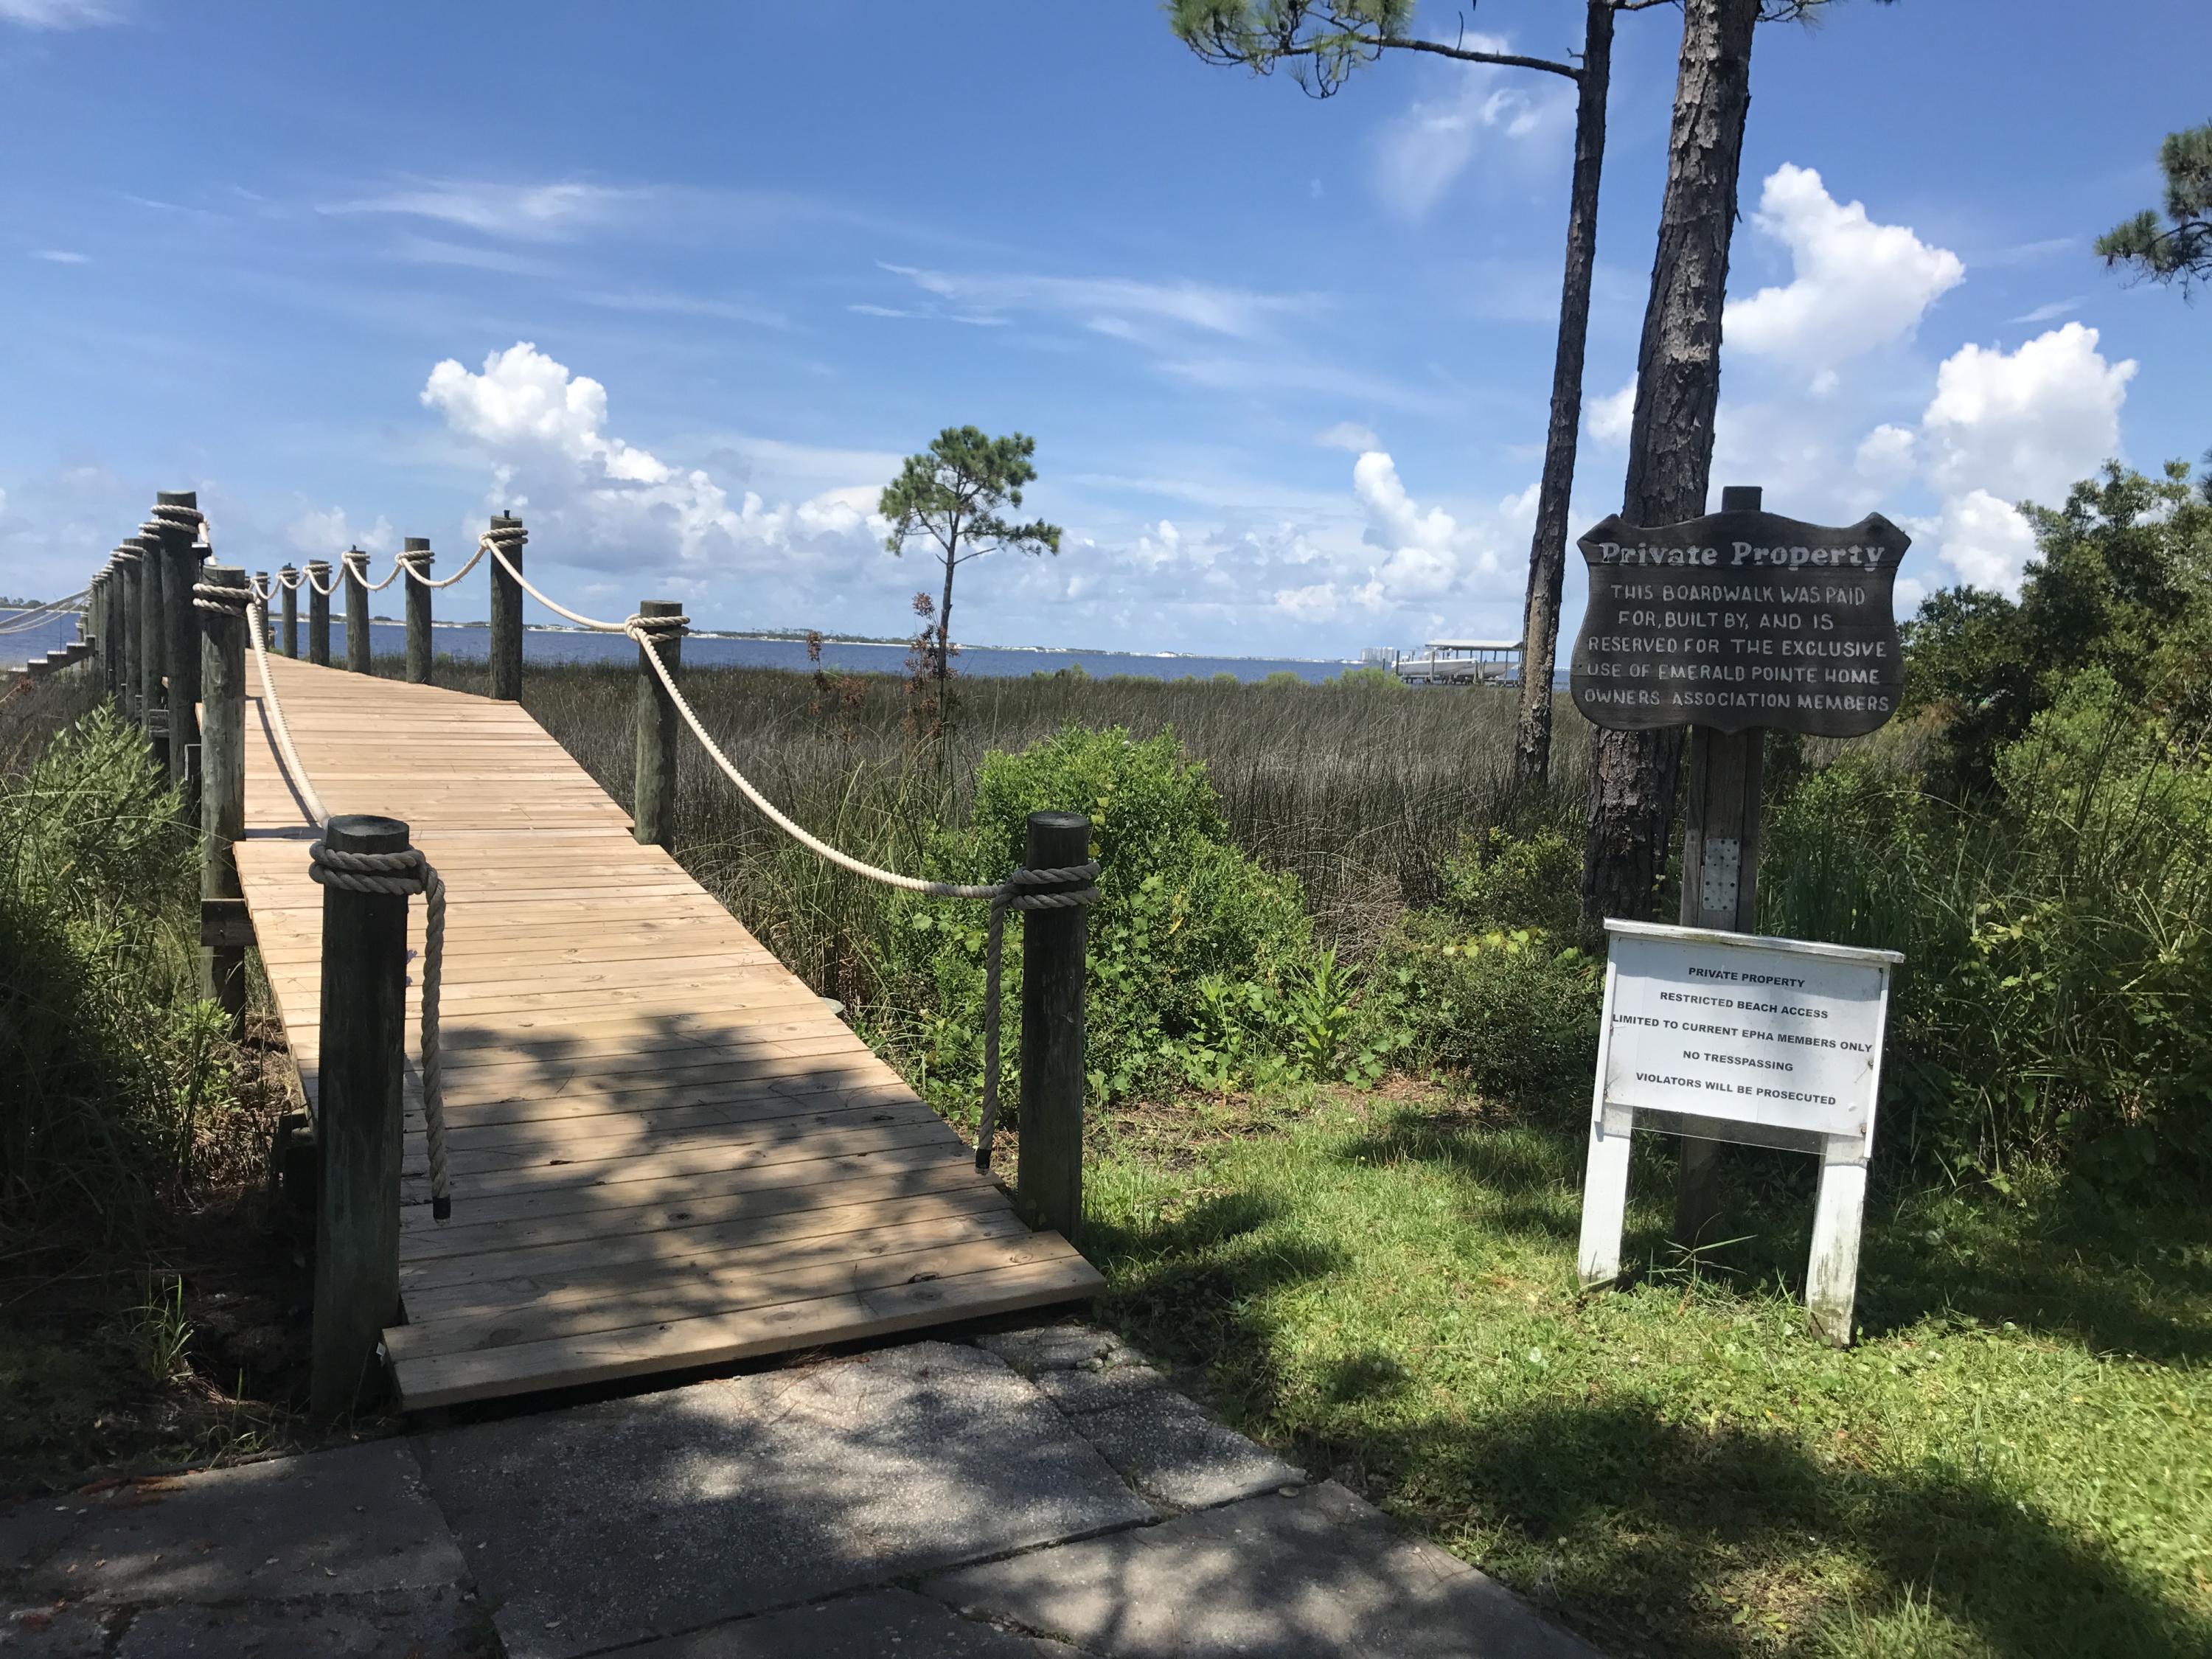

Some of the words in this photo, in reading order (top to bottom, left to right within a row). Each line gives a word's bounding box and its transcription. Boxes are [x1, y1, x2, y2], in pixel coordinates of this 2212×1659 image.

[1599, 542, 1717, 566] Private
[1731, 542, 1885, 572] Property
[1611, 585, 1653, 599] THIS
[1663, 585, 1773, 602] BOARDWALK
[1781, 587, 1820, 604] WAS
[1826, 588, 1865, 605] PAID
[1618, 611, 1662, 629] FOR,
[1665, 612, 1717, 627] BUILT
[1725, 613, 1749, 630] BY,
[1759, 613, 1801, 630] AND
[1813, 615, 1834, 630] IS
[1589, 637, 1677, 653] RESERVED
[1684, 639, 1719, 653] FOR
[1731, 639, 1773, 655] THE
[1782, 640, 1886, 658] EXCLUSIVE
[1587, 664, 1621, 677] USE
[1630, 664, 1650, 678] OF
[1658, 664, 1745, 681] EMERALD
[1752, 667, 1818, 683] POINTE
[1825, 668, 1880, 684] HOME
[1585, 689, 1660, 705] OWNERS
[1673, 692, 1790, 708] ASSOCIATION
[1797, 695, 1889, 711] MEMBERS
[1688, 967, 1739, 981] PRIVATE
[1741, 973, 1805, 988] PROPERTY
[1660, 992, 1733, 1008] RESTRICTED
[1737, 1001, 1778, 1013] BEACH
[1781, 1006, 1829, 1019] ACCESS
[1613, 1015, 1660, 1027] LIMITED
[1663, 1020, 1679, 1029] TO
[1682, 1022, 1739, 1036] CURRENT
[1742, 1030, 1774, 1041] EPHA
[1778, 1034, 1836, 1048] MEMBERS
[1840, 1041, 1873, 1052] ONLY
[1683, 1051, 1700, 1060] NO
[1704, 1053, 1793, 1071] TRESSPASSING
[1636, 1073, 1702, 1088] VIOLATORS
[1705, 1081, 1733, 1093] WILL
[1737, 1085, 1753, 1095] BE
[1756, 1088, 1836, 1105] PROSECUTED
